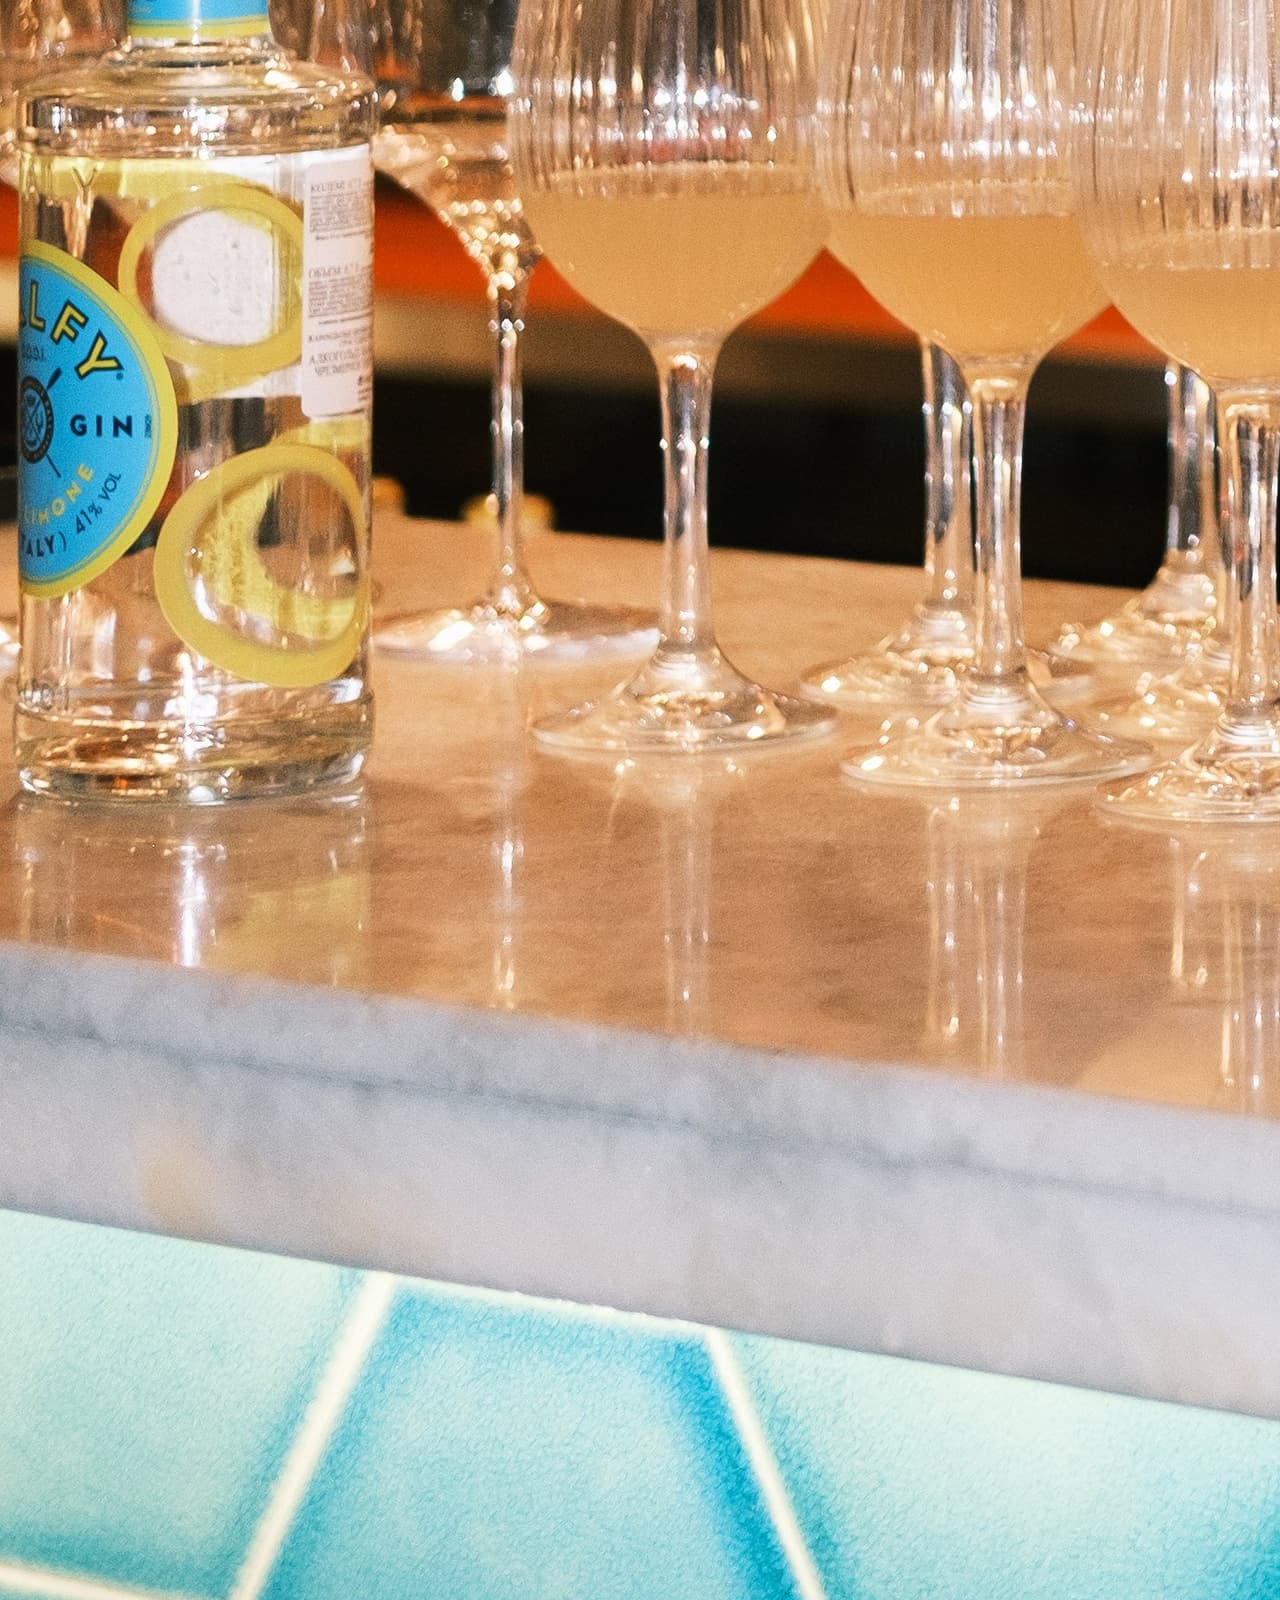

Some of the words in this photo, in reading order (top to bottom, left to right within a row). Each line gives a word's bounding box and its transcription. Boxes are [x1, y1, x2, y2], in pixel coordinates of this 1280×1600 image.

[20, 278, 125, 381] LFY
[69, 413, 134, 438] GIN
[75, 502, 103, 535] 41%
[98, 473, 122, 502] VOL
